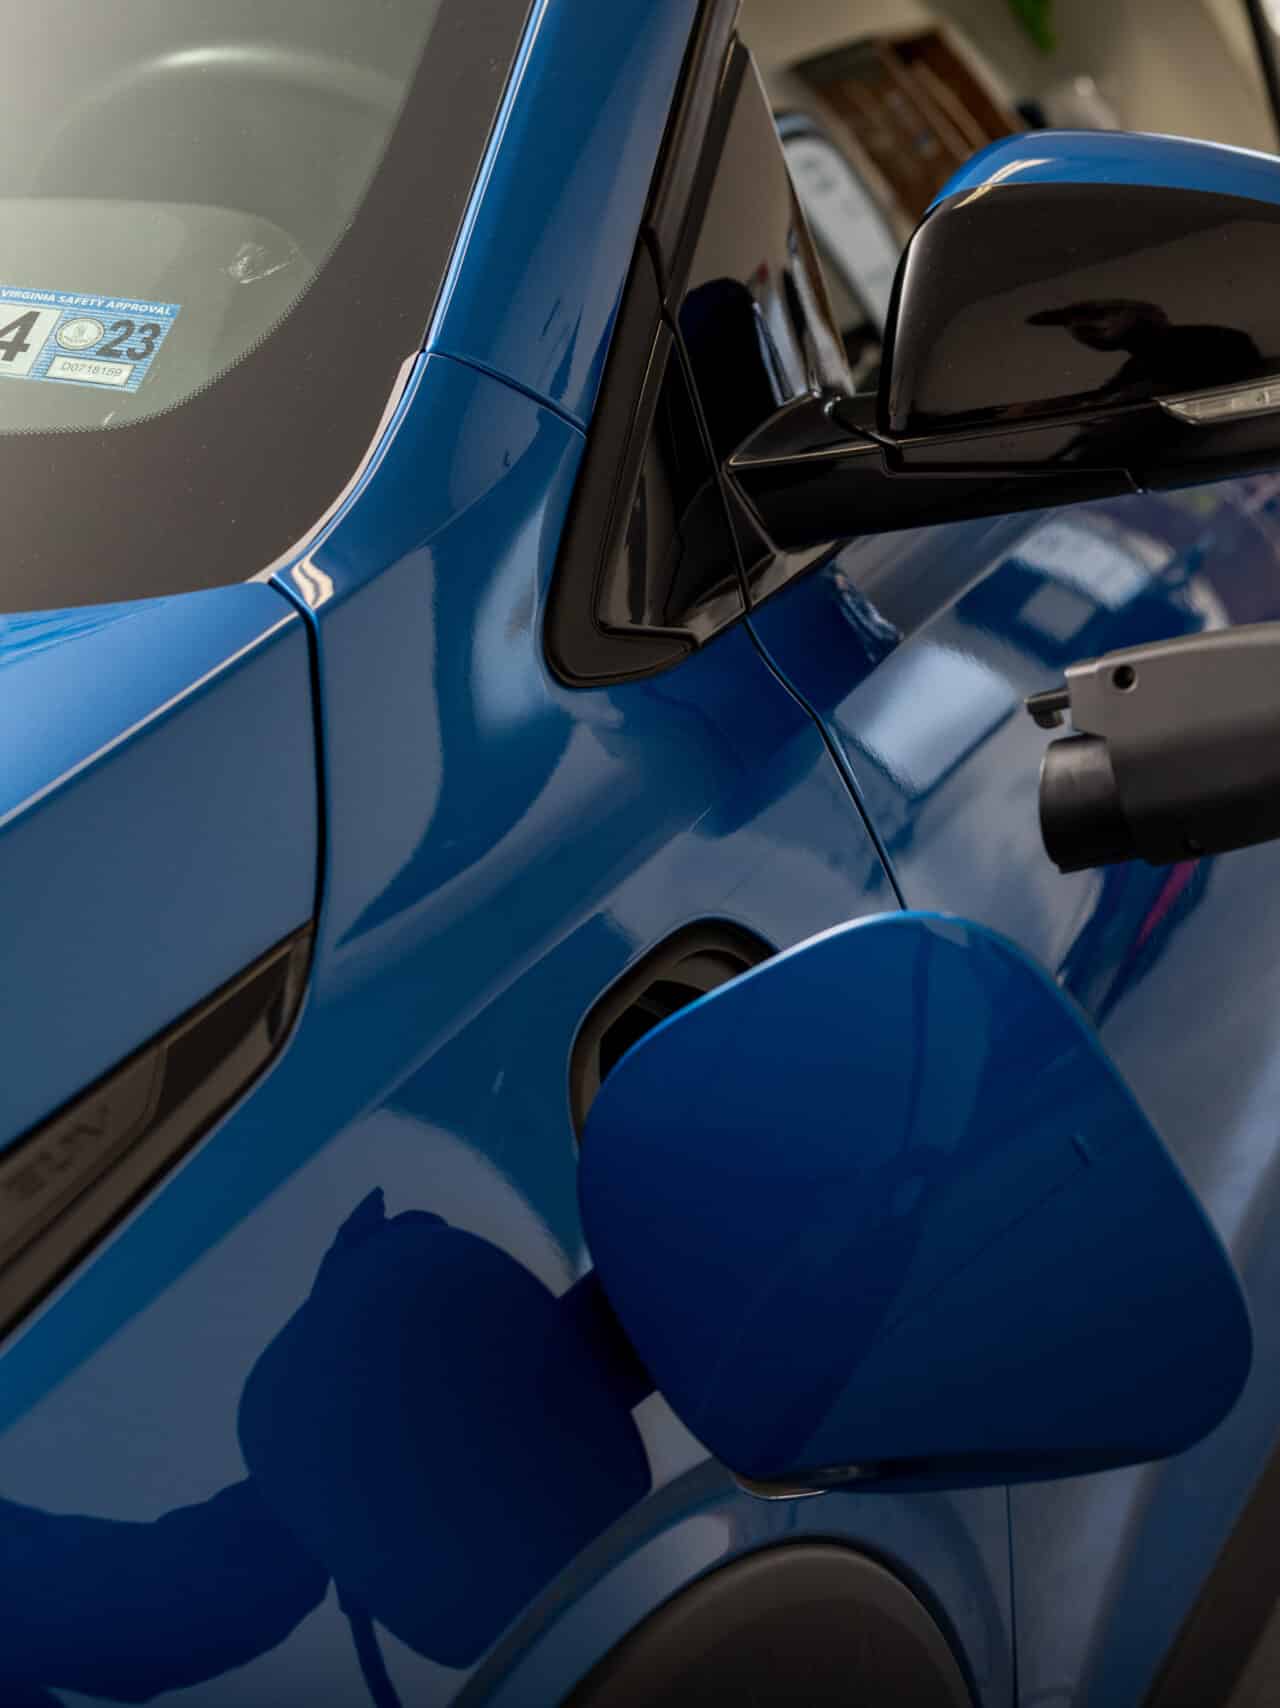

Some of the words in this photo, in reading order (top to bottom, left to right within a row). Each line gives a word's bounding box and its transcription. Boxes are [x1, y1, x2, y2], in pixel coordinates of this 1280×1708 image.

[1, 289, 56, 302] VIRGINIA
[58, 295, 105, 307] SAFETY
[105, 302, 172, 316] APPROVAL
[0, 311, 41, 361] 4
[96, 319, 161, 360] 23
